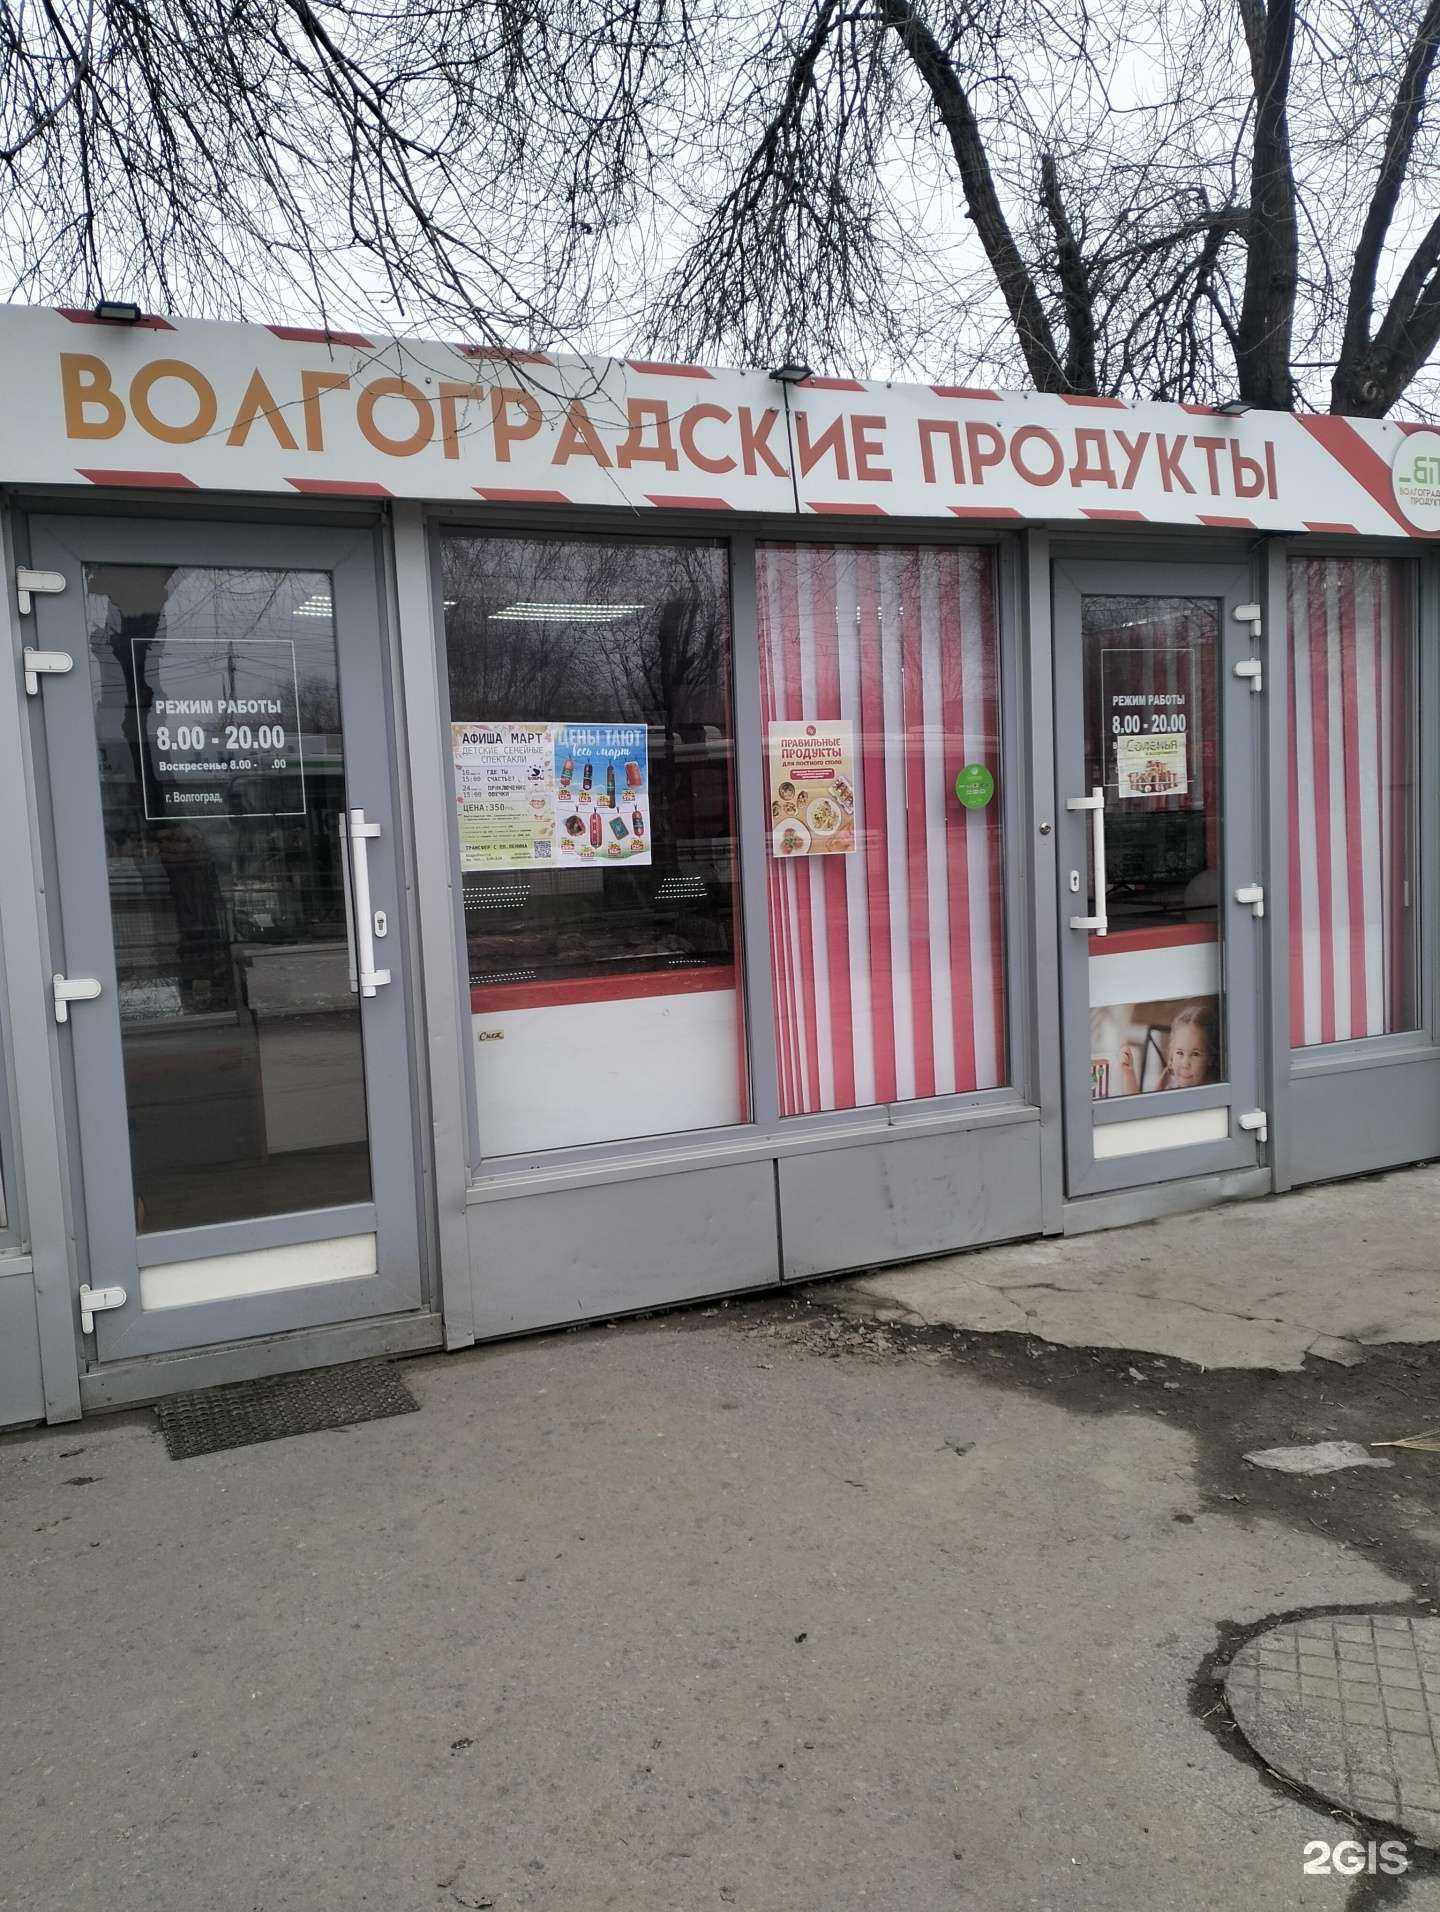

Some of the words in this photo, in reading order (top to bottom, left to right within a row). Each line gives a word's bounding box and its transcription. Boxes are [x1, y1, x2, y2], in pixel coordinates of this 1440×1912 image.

[60, 352, 892, 482] ВОЛГОГРАДСКИЕ
[918, 418, 1279, 500] ПРОДУКТЫ
[155, 700, 213, 714] РЕЖИМ
[218, 700, 282, 714] РАБОТЫ
[1112, 695, 1146, 706] РЕЖИМ
[1148, 695, 1185, 705] РАБОТЫ
[1112, 715, 1141, 733] 8.00
[1151, 714, 1187, 732] 20.00
[156, 726, 205, 750] 8.00
[225, 725, 285, 749] 20.00
[462, 732, 503, 745] АФИША
[511, 732, 543, 744] МАРТ
[558, 729, 600, 748] ЦЕНЫ
[606, 729, 642, 747] ТАЮТ
[781, 739, 841, 748] ПРАВИЛЬНЫЕ
[462, 746, 498, 755] ДЕТСКИЕ
[781, 747, 842, 760] ПРОДУКТЫ
[159, 760, 228, 772] Воскресенье
[230, 759, 251, 770] 8.00
[481, 755, 527, 763] СПЕКТАКЛИ
